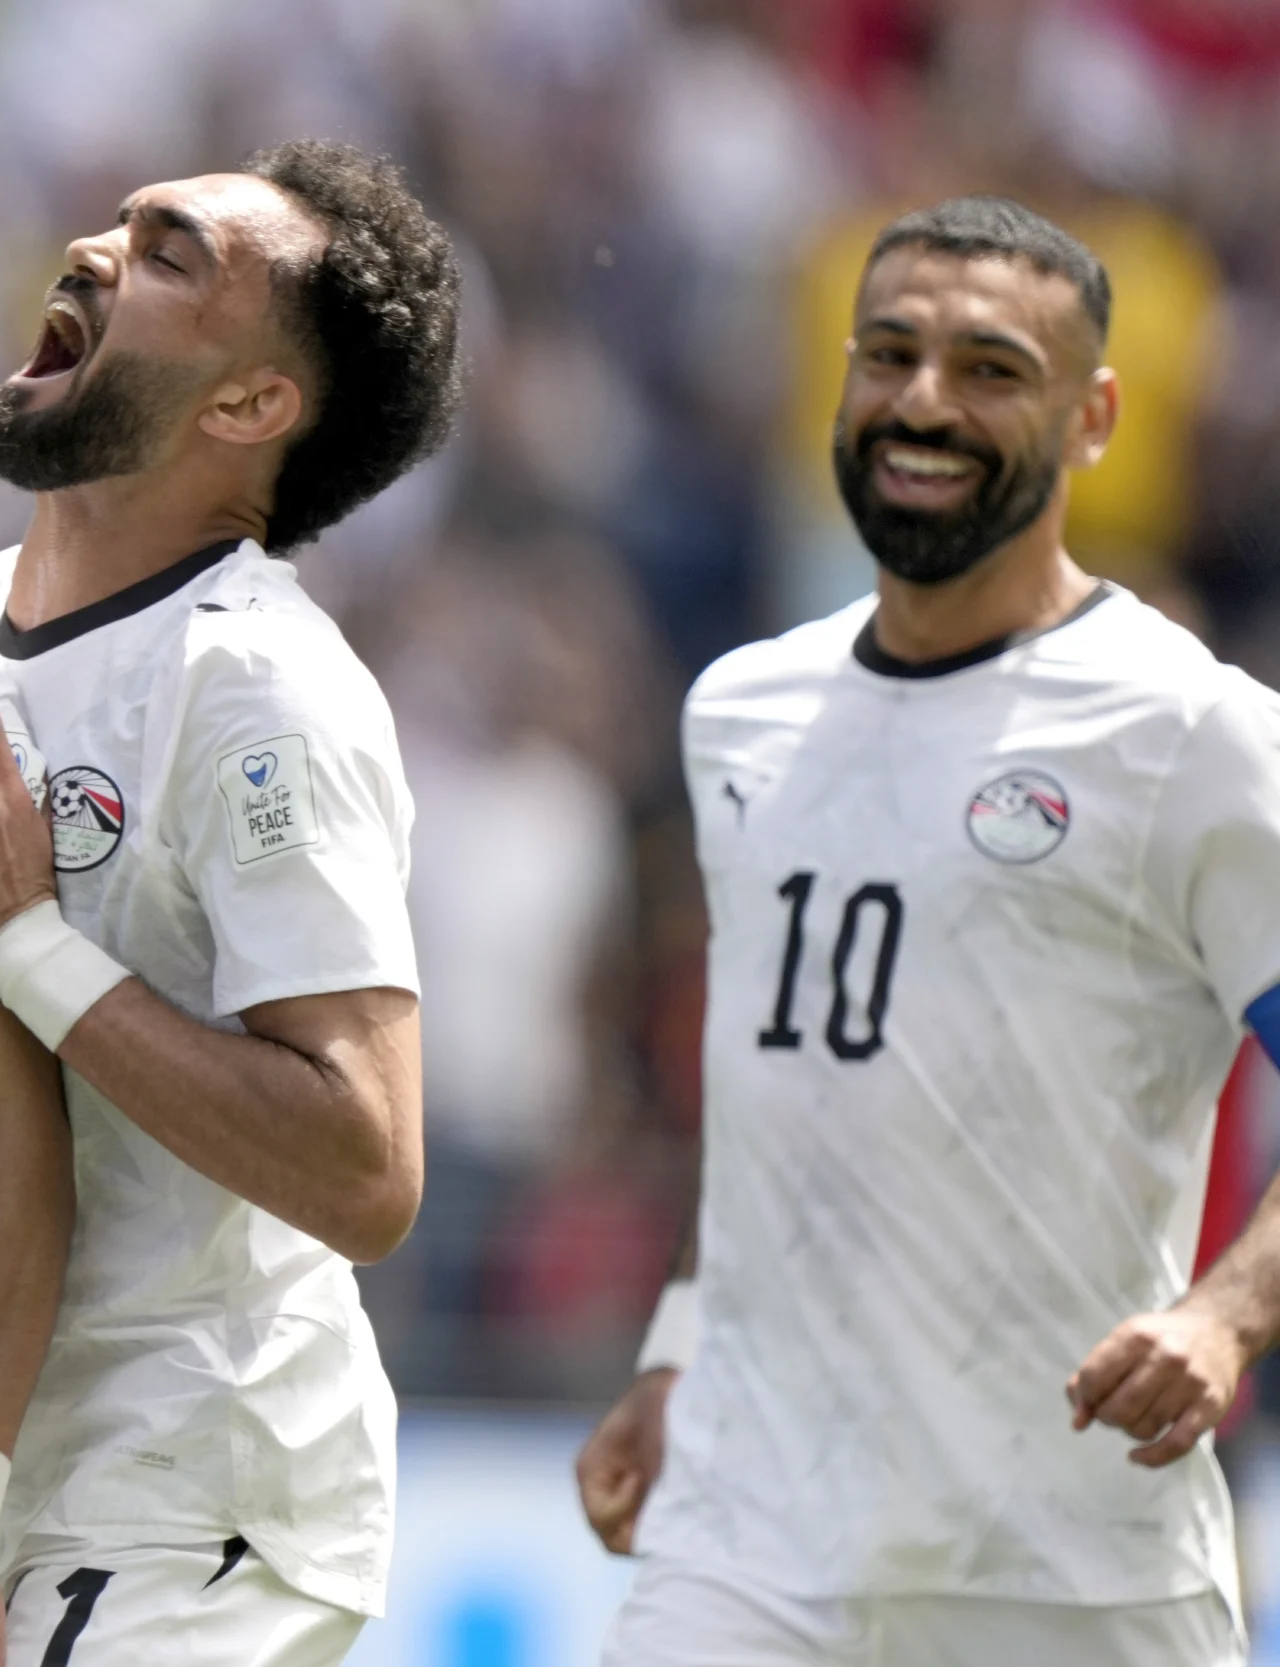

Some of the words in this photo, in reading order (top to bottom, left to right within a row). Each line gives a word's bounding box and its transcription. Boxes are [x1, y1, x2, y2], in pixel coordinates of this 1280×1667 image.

[241, 792, 270, 816] Unite
[271, 784, 293, 806] For
[248, 806, 294, 837] PEACE
[261, 833, 286, 849] FIFA
[757, 871, 904, 1062] 10
